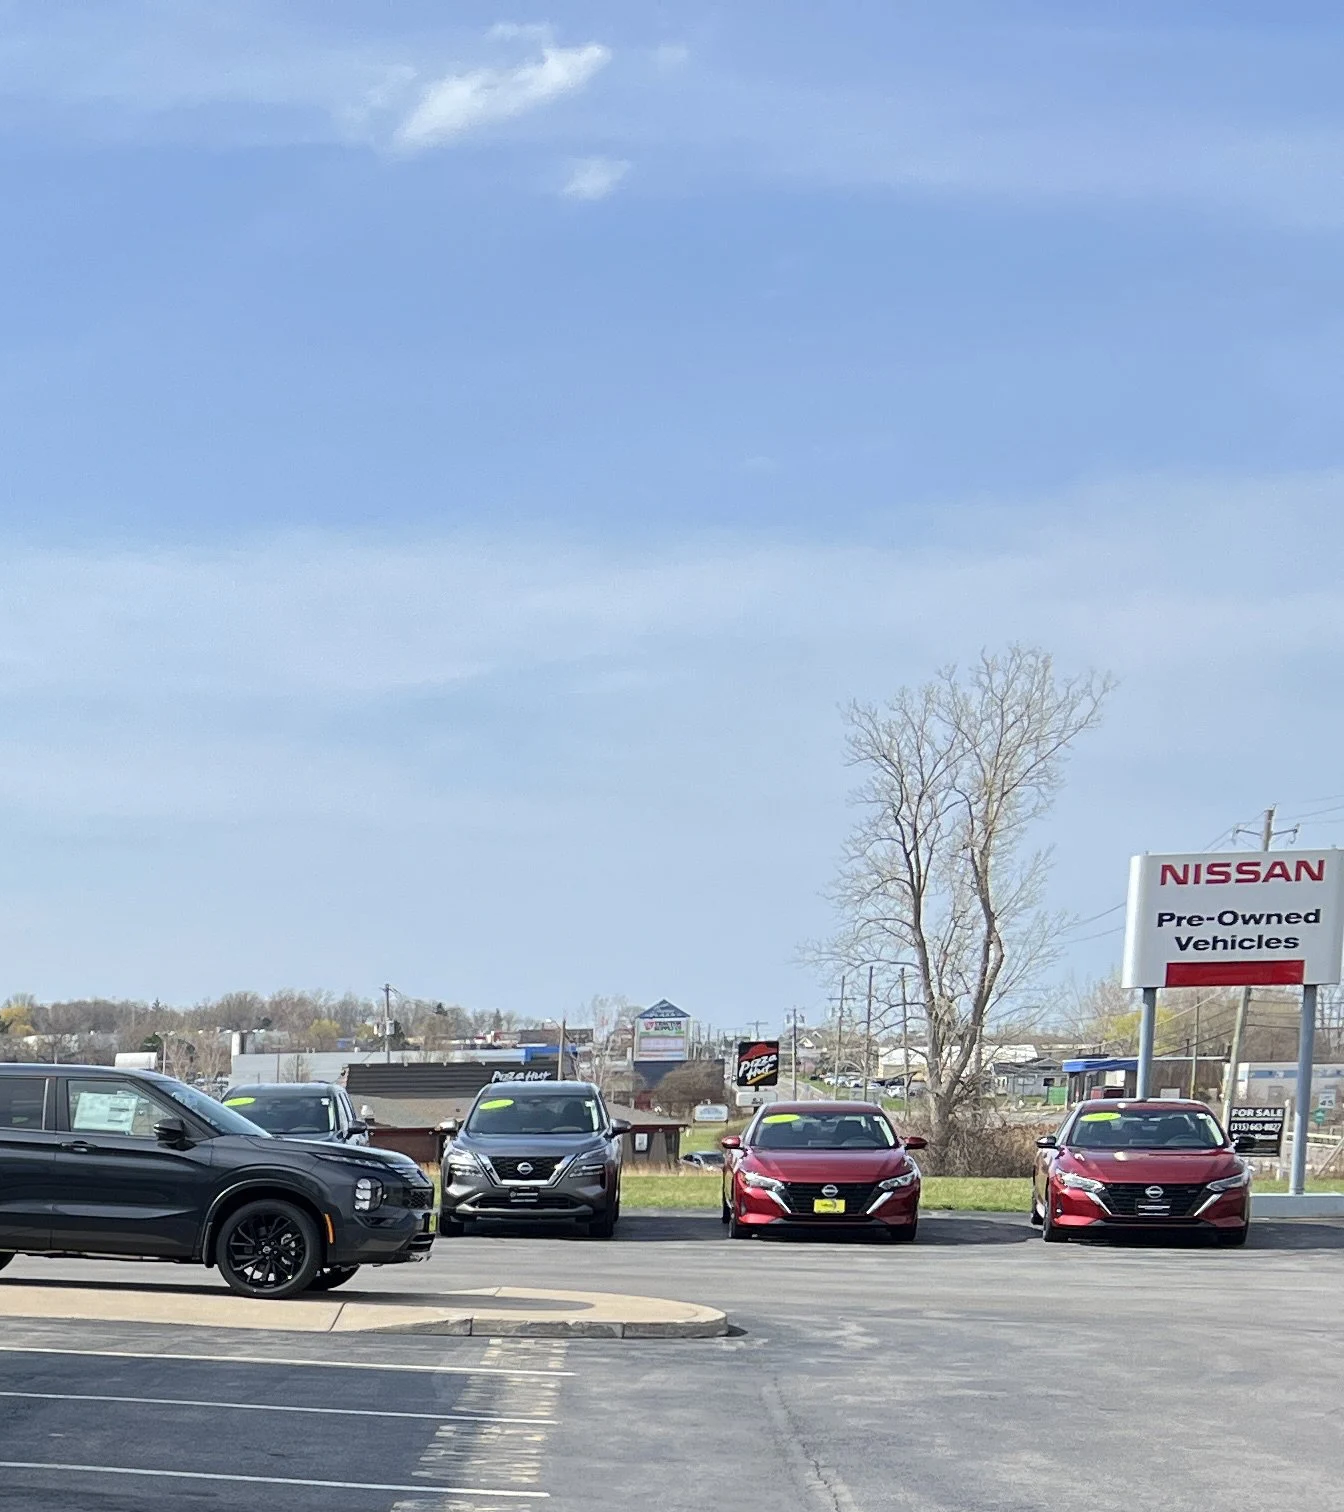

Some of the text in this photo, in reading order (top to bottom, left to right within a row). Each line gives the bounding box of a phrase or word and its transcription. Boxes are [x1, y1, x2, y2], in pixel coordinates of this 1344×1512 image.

[1159, 860, 1326, 886] NISSAN
[1157, 909, 1322, 928] Pre-Owned
[1174, 934, 1301, 951] Vehicles
[746, 1063, 775, 1081] Hut
[1232, 1108, 1284, 1117] FOR SALE
